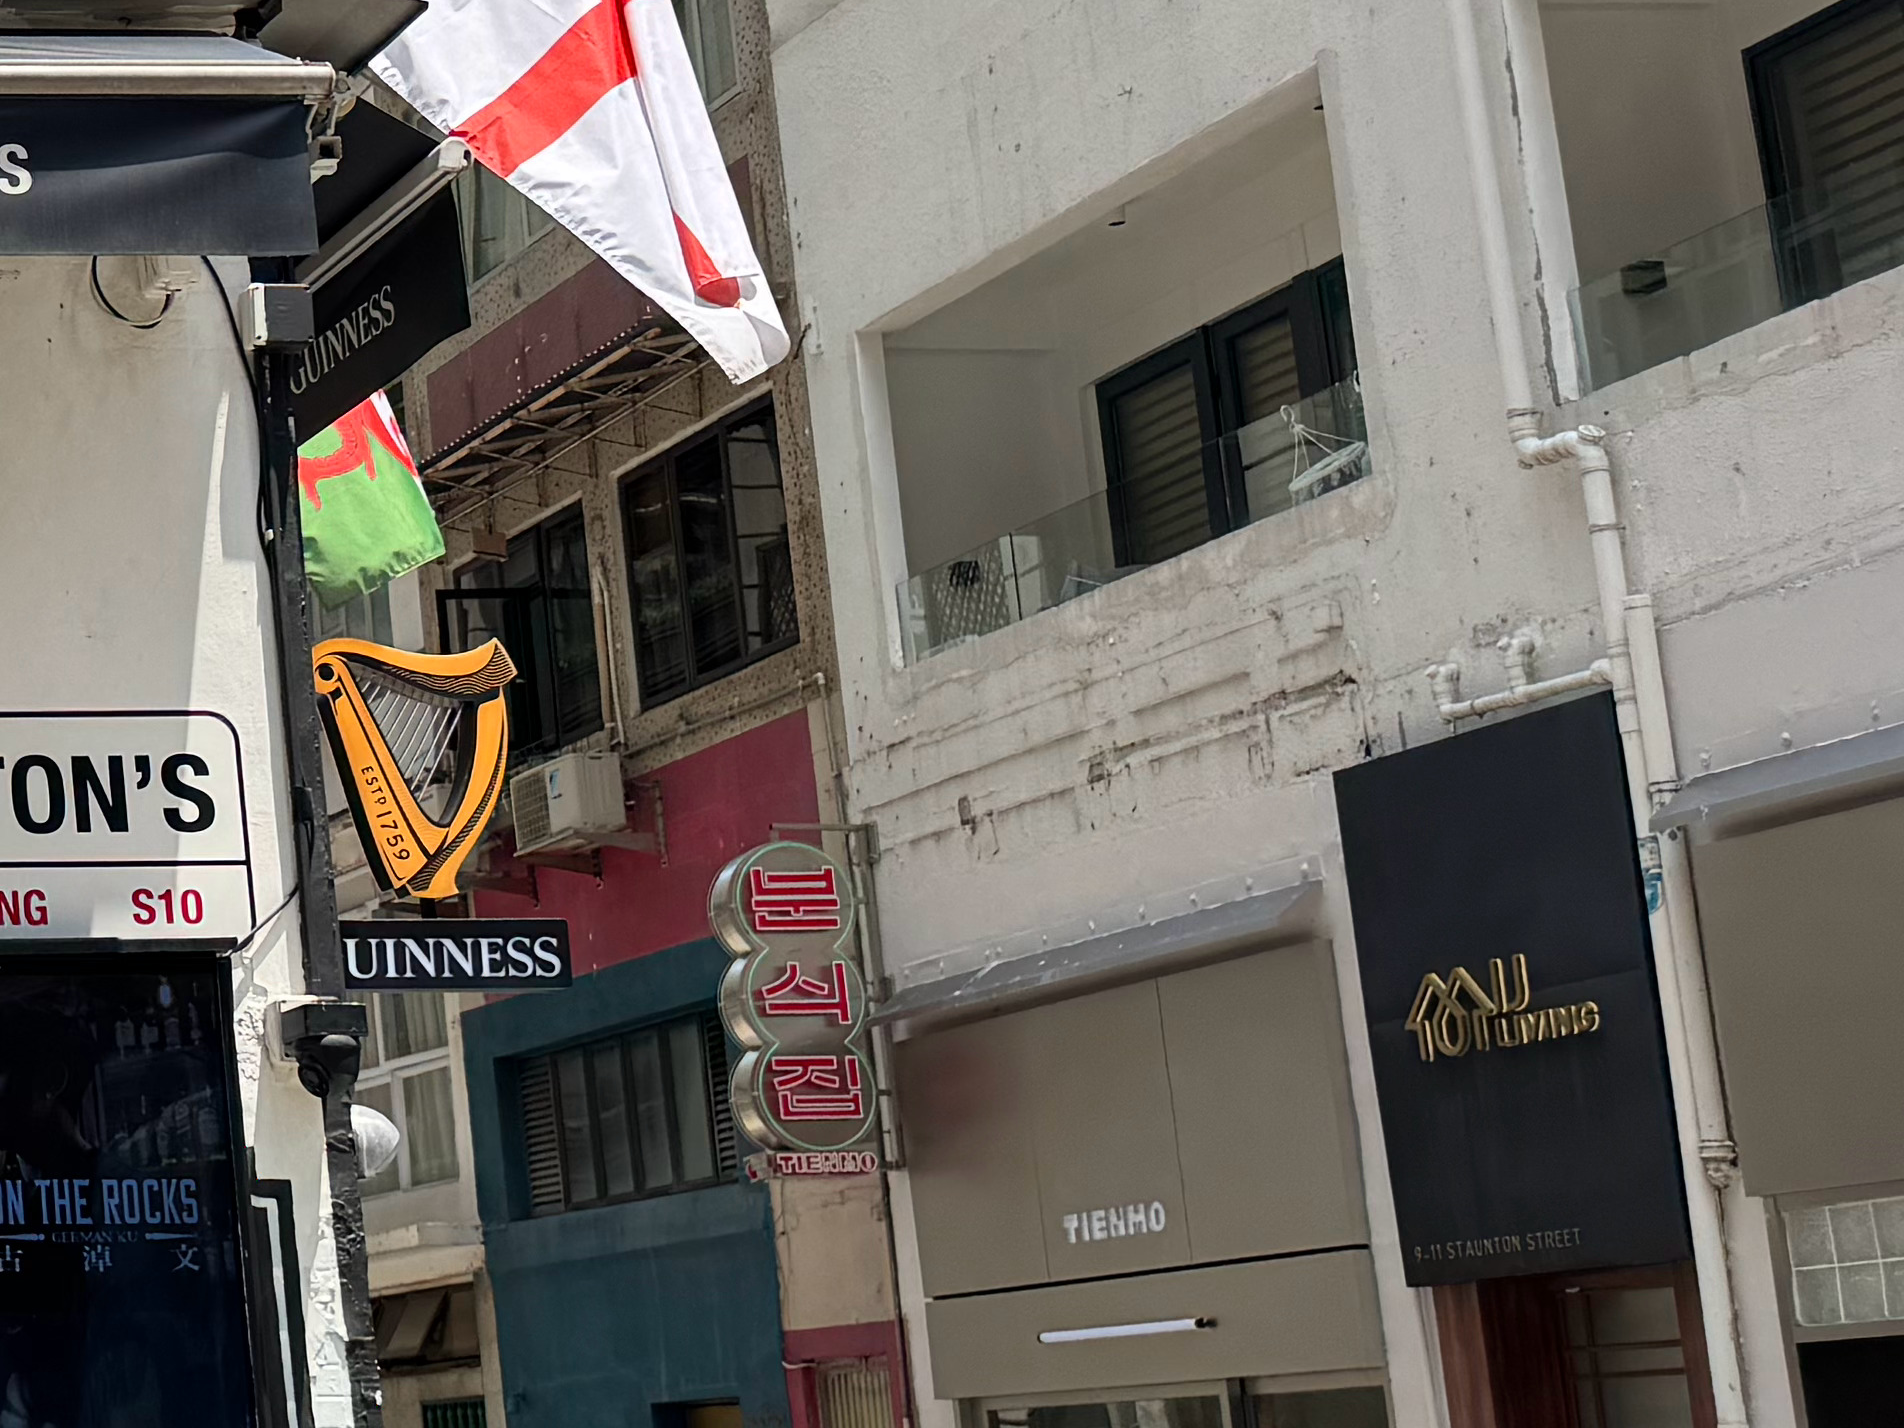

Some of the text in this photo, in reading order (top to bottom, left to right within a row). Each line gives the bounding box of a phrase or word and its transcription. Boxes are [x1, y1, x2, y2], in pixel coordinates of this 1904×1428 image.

[290, 285, 396, 395] GUINNESS
[375, 809, 411, 862] 1759
[132, 887, 204, 926] S10
[344, 936, 562, 979] UINNESS
[749, 865, 863, 1120] 분식집
[34, 1179, 92, 1225] THE
[102, 1178, 199, 1224] ROCKS
[1063, 1201, 1166, 1244] TIENMO
[1446, 1234, 1522, 1259] STAUNTON
[1526, 1227, 1581, 1251] STREET
